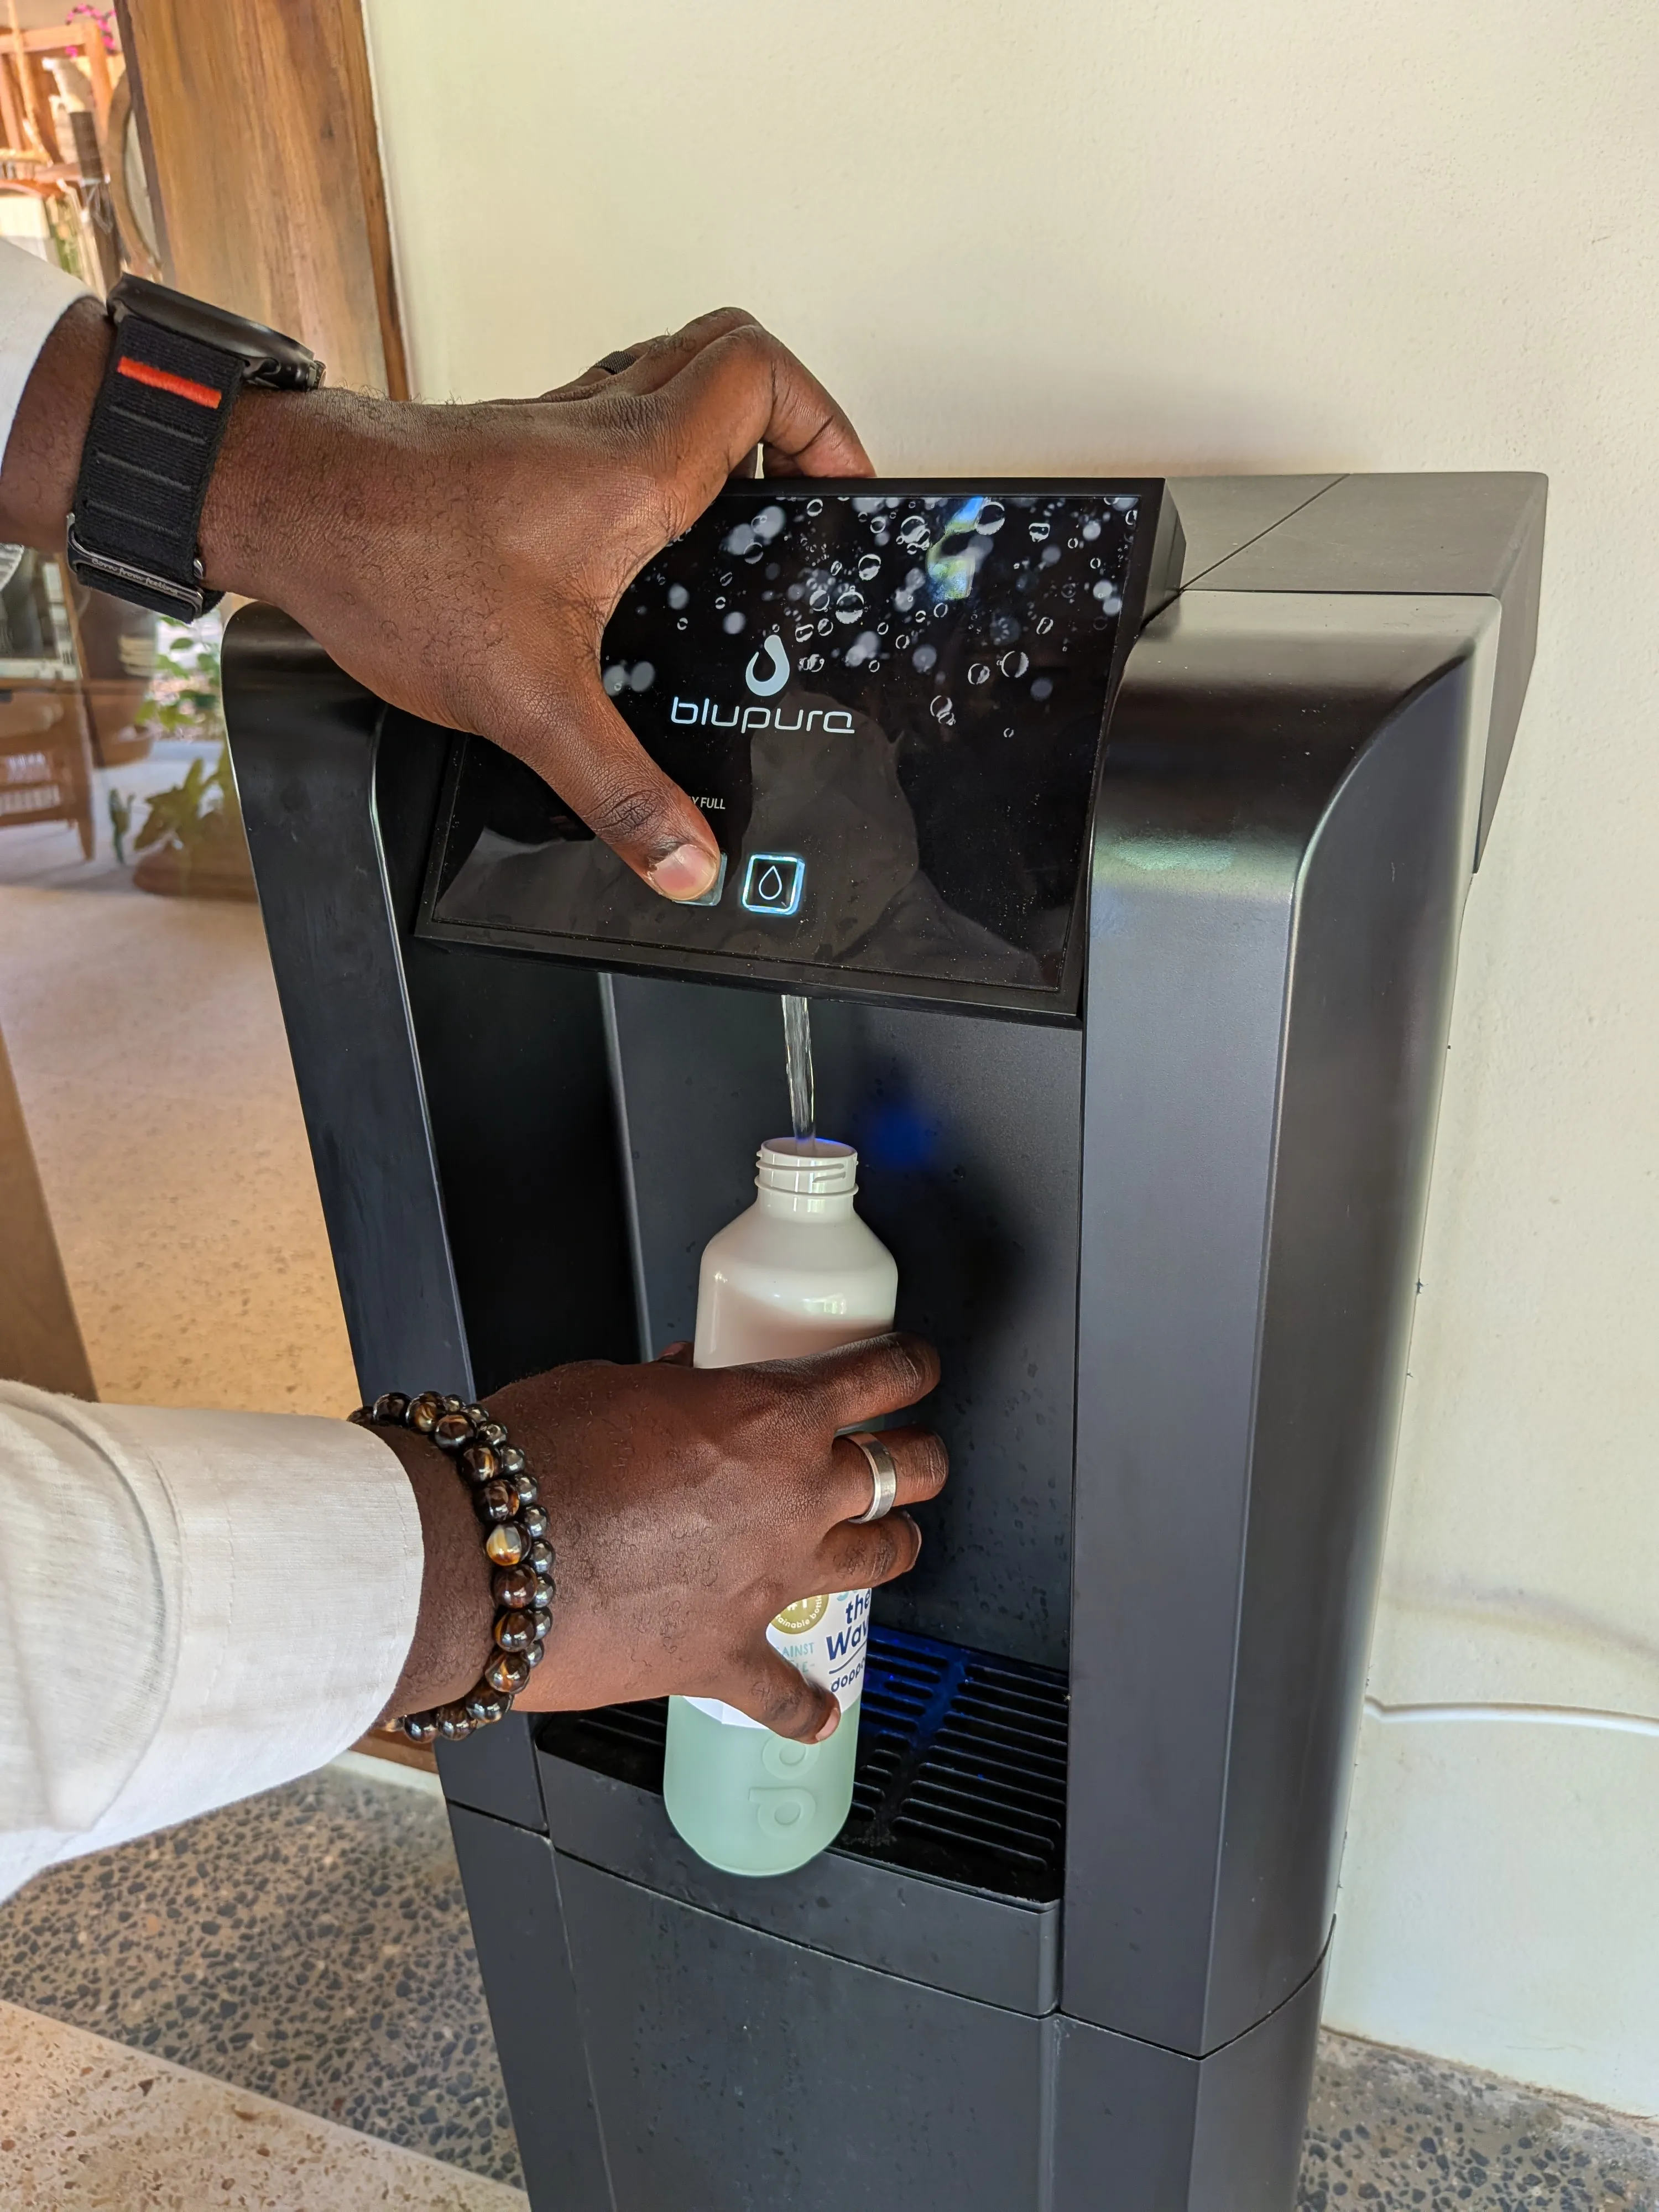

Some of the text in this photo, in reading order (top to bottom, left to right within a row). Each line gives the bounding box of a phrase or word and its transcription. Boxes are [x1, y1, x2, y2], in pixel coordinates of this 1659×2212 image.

[670, 696, 855, 734] blupura
[700, 797, 726, 810] FULL
[846, 1589, 870, 1624] the
[776, 1642, 815, 1657] AINST
[826, 1615, 868, 1661] Wav
